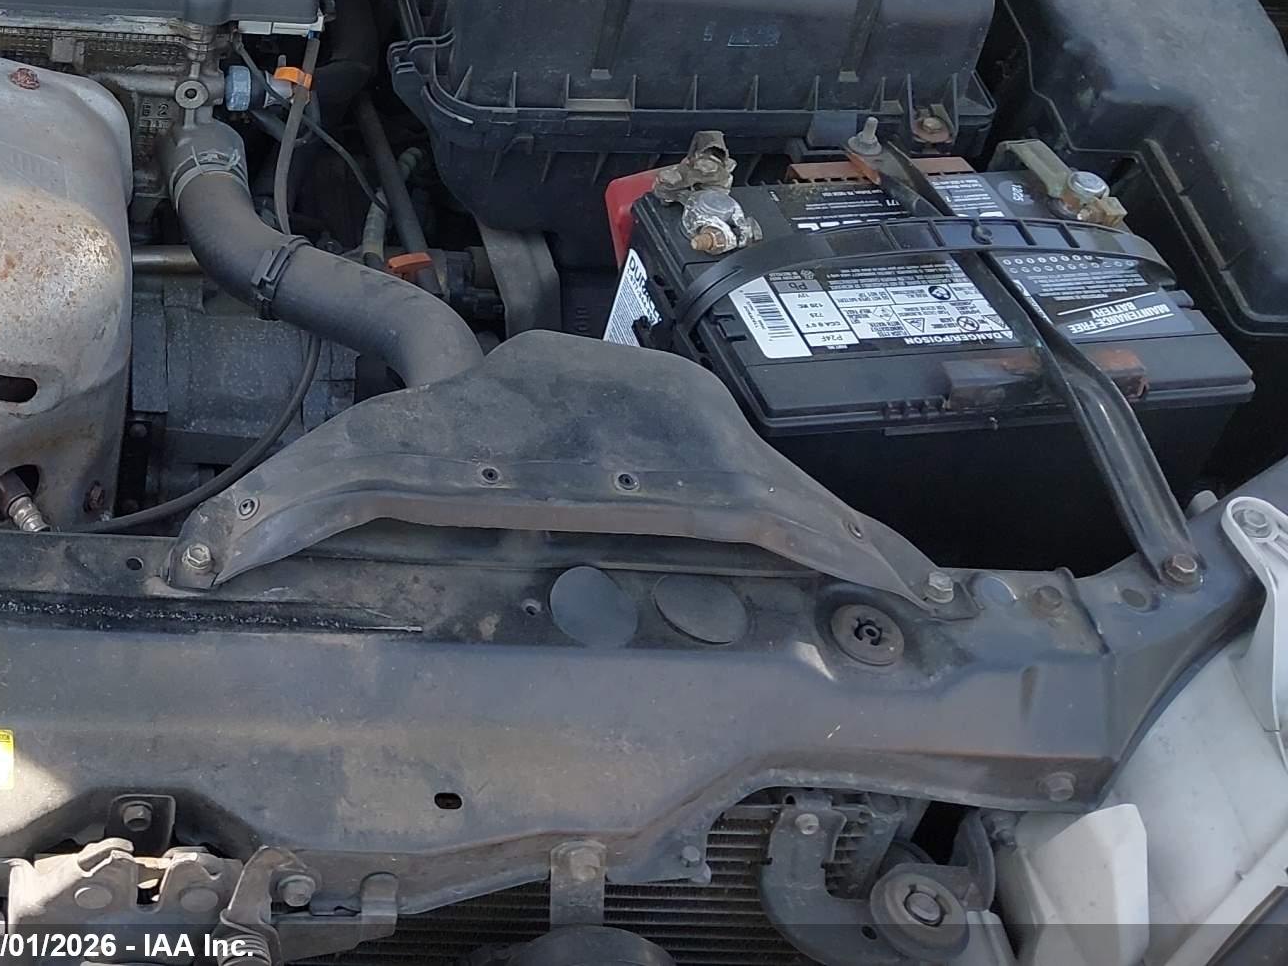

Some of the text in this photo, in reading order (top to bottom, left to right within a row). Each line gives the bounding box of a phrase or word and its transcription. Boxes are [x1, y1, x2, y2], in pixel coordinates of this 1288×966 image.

[789, 282, 808, 291] Pb
[1088, 300, 1137, 319] BATTERY
[1067, 303, 1171, 333] MAINTENANCE-FREE
[820, 333, 844, 342] P24F
[903, 330, 1003, 345] DANGER/POISON
